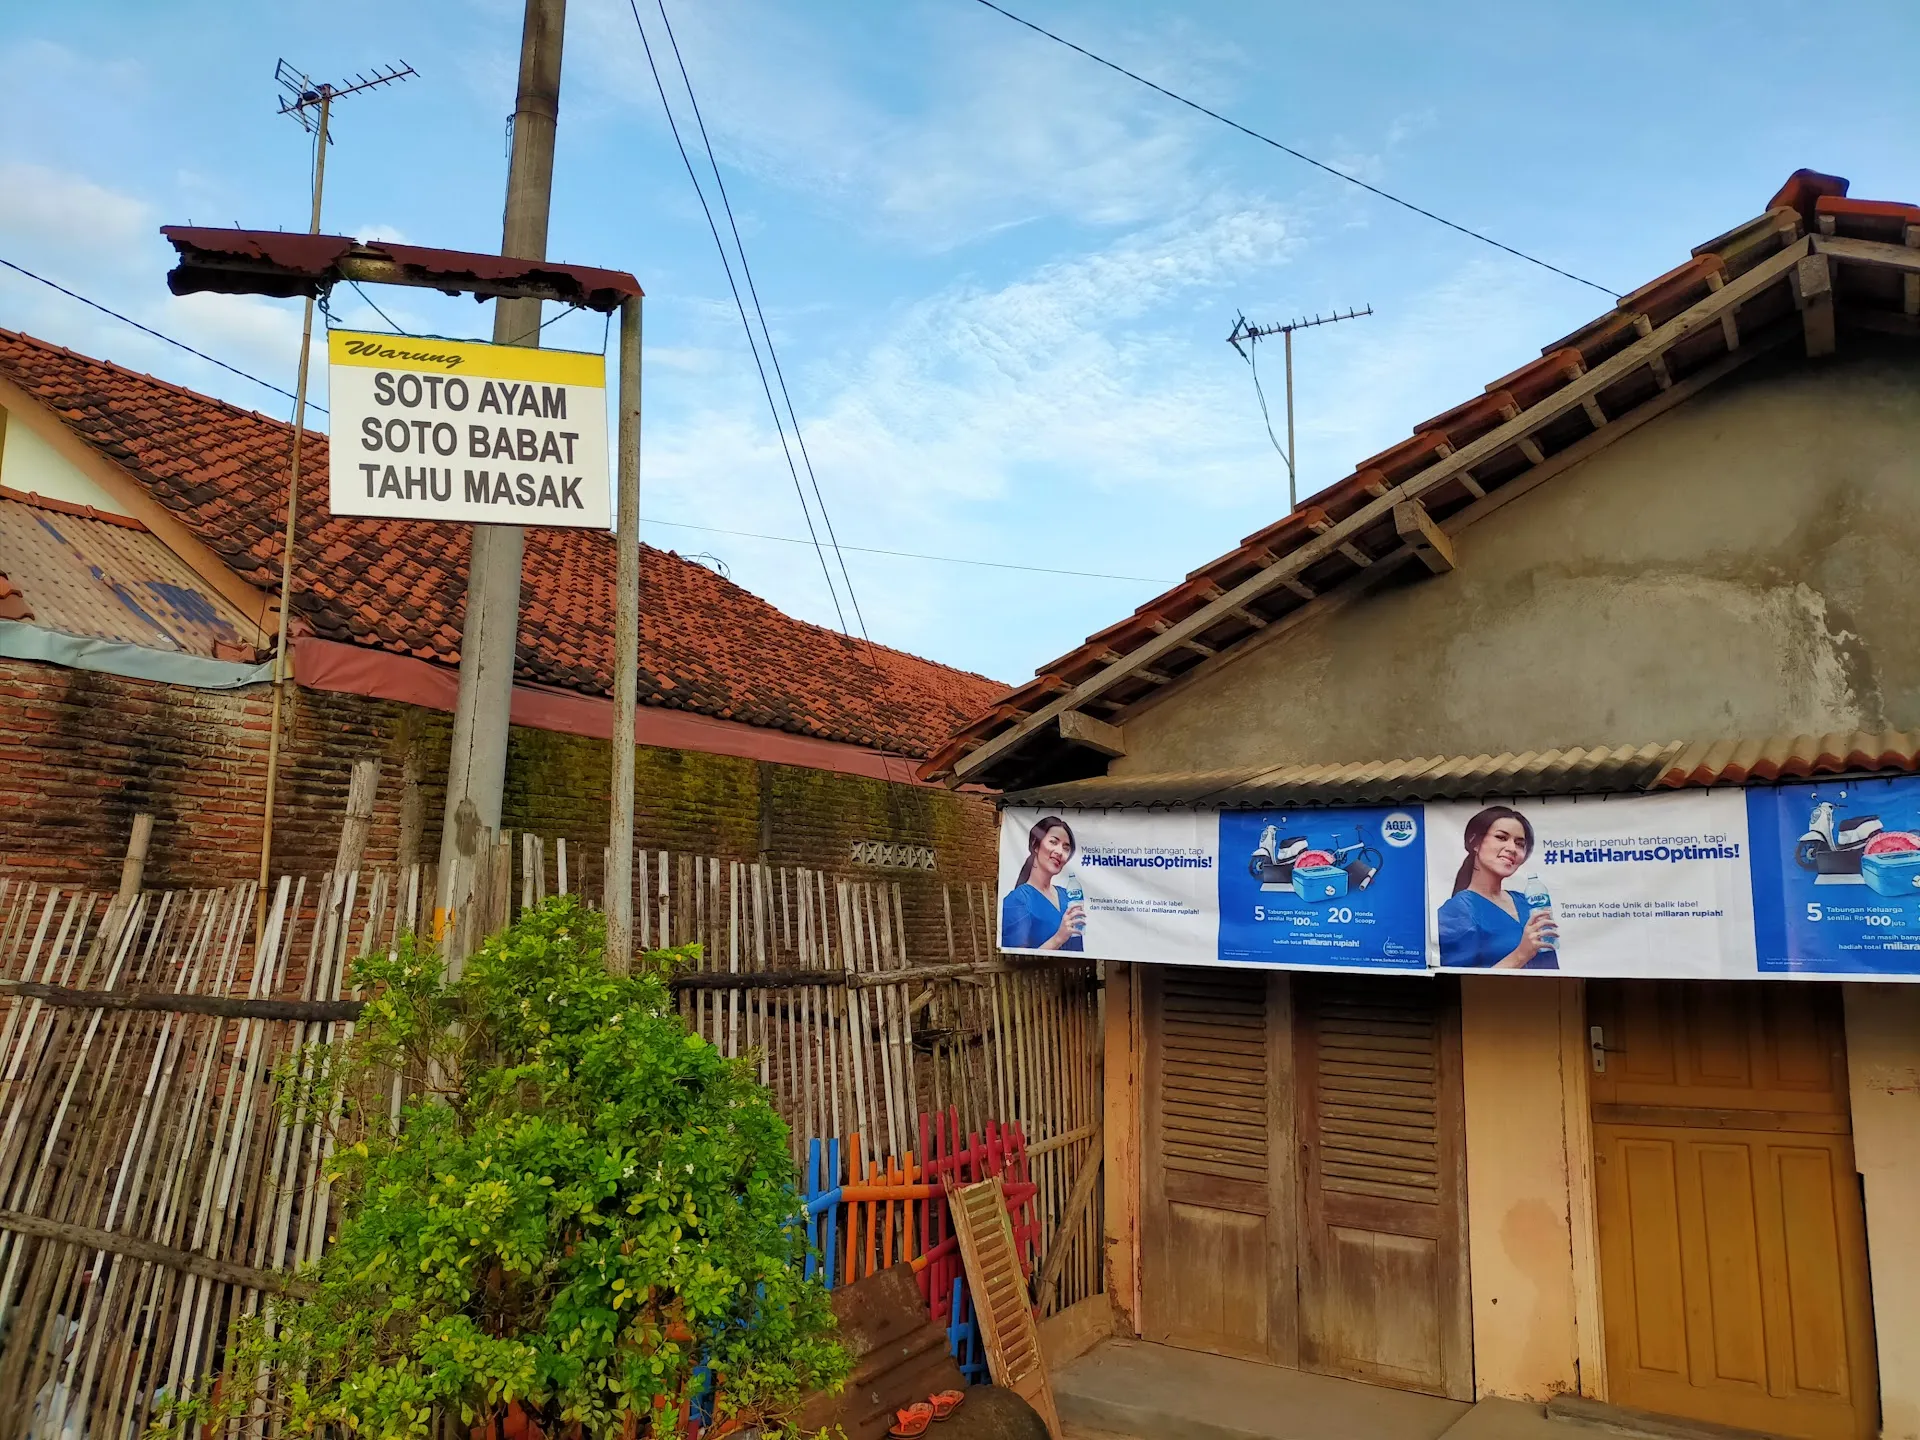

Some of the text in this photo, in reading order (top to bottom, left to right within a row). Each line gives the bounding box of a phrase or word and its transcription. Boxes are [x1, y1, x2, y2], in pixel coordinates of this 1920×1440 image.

[345, 340, 465, 369] Warung
[374, 372, 567, 420] SOTO AYAM
[361, 417, 579, 464] SOTO BABAT
[359, 463, 585, 510] TAHU MASAK
[1385, 820, 1413, 831] AQUA
[1543, 832, 1727, 850] Meski hari penuh tantangan, tapi
[1081, 846, 1204, 857] Meski hari penuh tantangan, tapi
[1544, 844, 1740, 865] #HatiHarusOptimis!
[1081, 855, 1212, 870] #HatiHarusOptimis!
[1254, 905, 1265, 921] 5
[1623, 901, 1642, 909] Unik
[1677, 900, 1698, 908] label
[1807, 902, 1823, 921] 5
[1826, 906, 1903, 914] Tabungan Keluarga
[1327, 907, 1352, 924] 20
[1602, 910, 1630, 918] hadiah
[1633, 910, 1652, 918] total
[1692, 909, 1723, 918] rupiah!
